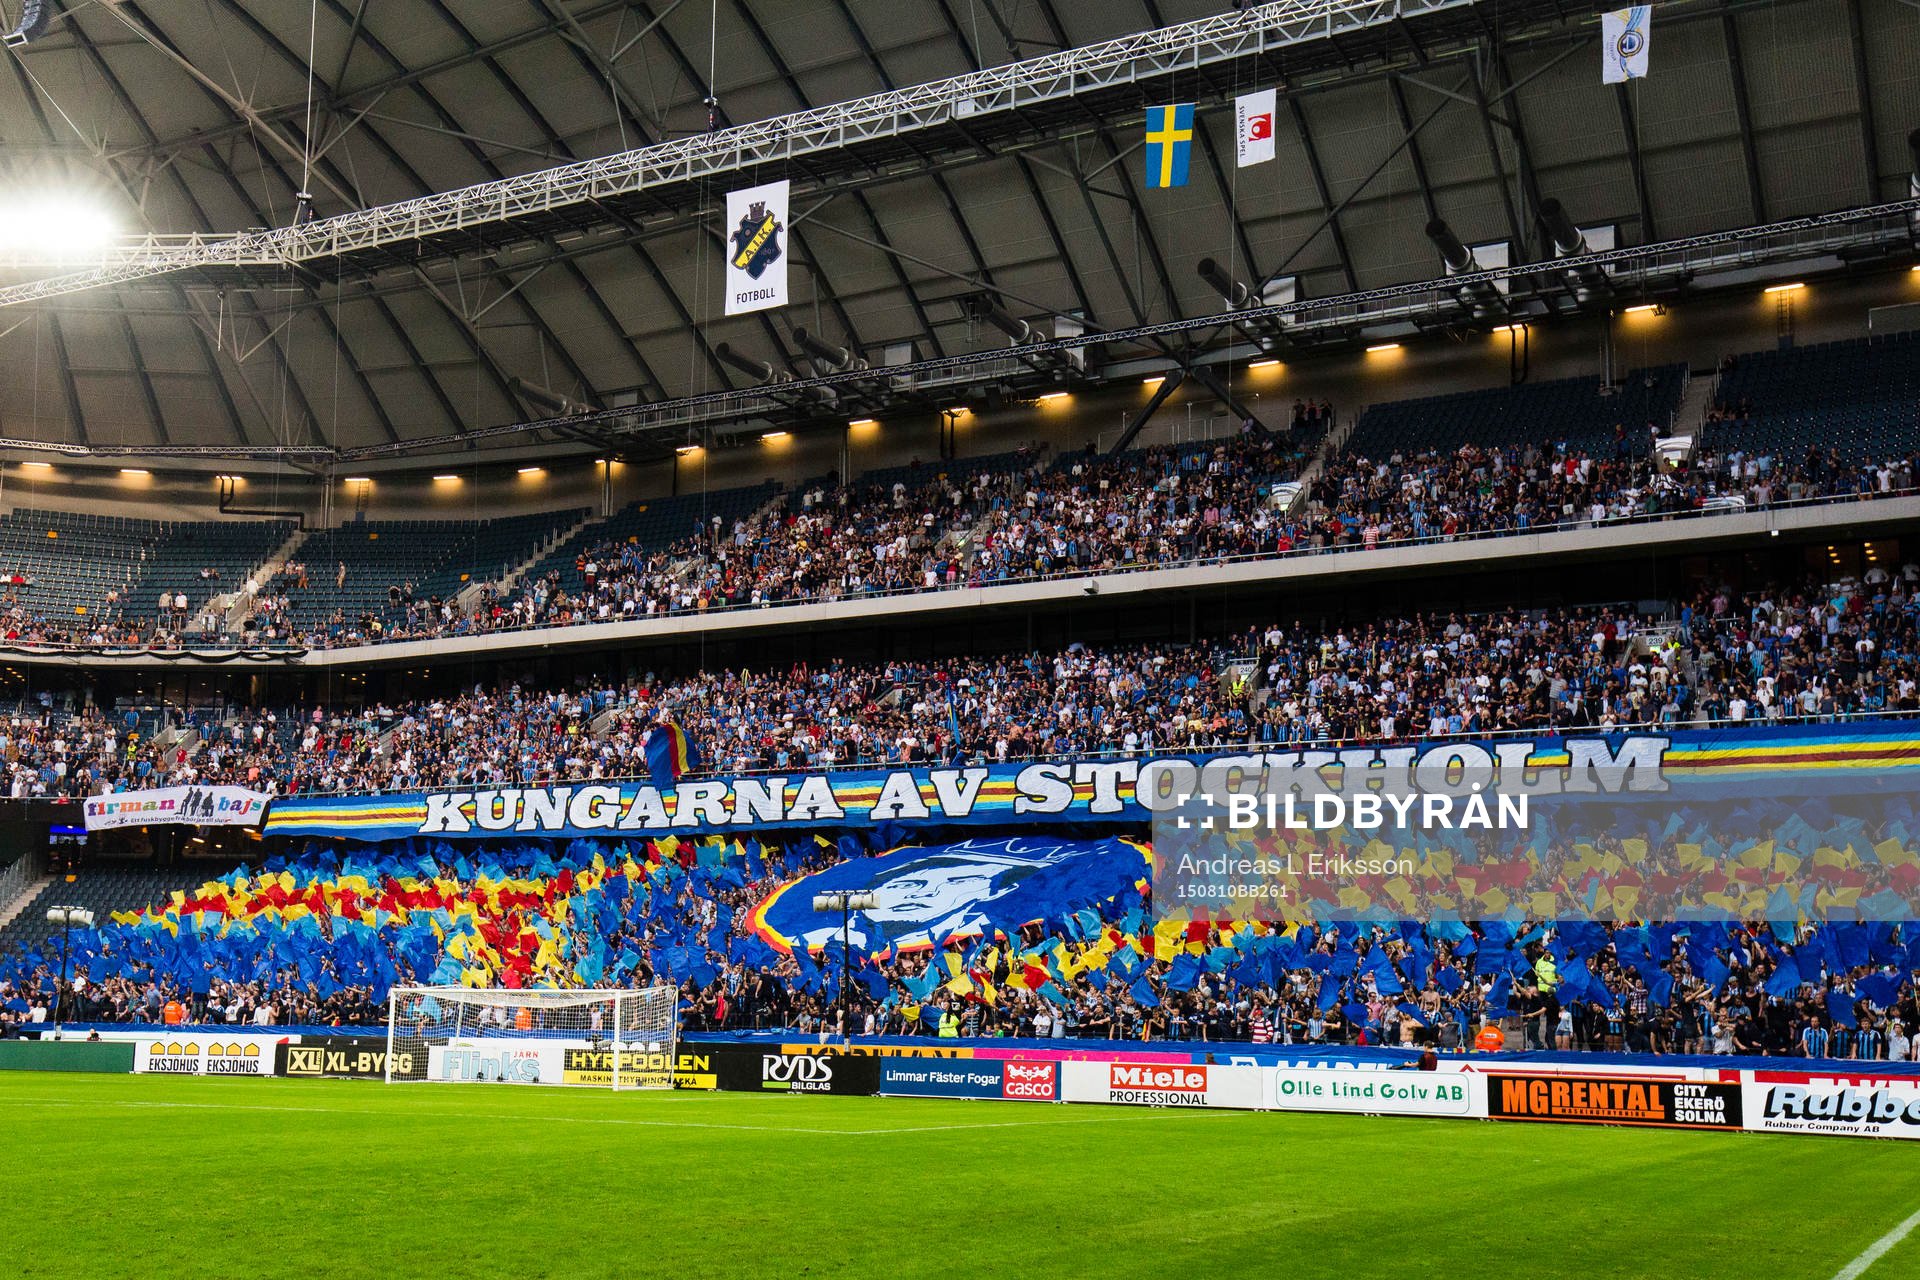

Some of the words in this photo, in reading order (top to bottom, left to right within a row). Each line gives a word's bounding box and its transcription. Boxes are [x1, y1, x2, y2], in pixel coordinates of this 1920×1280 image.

[1239, 140, 1247, 158] SPEL
[736, 287, 776, 304] FOTBOLL
[1648, 636, 1664, 645] 239
[418, 775, 847, 833] KUNGARNA
[869, 767, 989, 821] AV
[1014, 736, 1672, 816] STOCKHOLM
[217, 796, 263, 816] bajs
[149, 1055, 199, 1073] EKSJÖHUS
[207, 1056, 259, 1074] EKSJÖHUS
[289, 1050, 321, 1071] XL
[325, 1051, 413, 1074] XL-BYGG
[442, 1050, 540, 1081] Flinks
[571, 1052, 710, 1071] HYRPOOLEN
[762, 1054, 833, 1081] RYDS
[580, 1074, 664, 1084] MASKINTHYRNING
[791, 1081, 831, 1091] BILGLAS
[886, 1069, 928, 1083] Limmar
[929, 1071, 966, 1084] Fäster
[967, 1073, 1001, 1087] Fogar
[1111, 1065, 1206, 1090] Miele
[1005, 1082, 1053, 1097] casco
[1109, 1091, 1208, 1106] PROFESSIONAL
[1281, 1079, 1323, 1096] Olle
[1332, 1081, 1374, 1098] Lind
[1379, 1082, 1428, 1100] Golv
[1435, 1085, 1464, 1102] AB
[1673, 1084, 1708, 1097] CITY
[1674, 1096, 1725, 1111] EKERÖ
[1674, 1110, 1727, 1124] SOLNA
[1764, 1120, 1804, 1130] Rubber
[1807, 1122, 1860, 1133] Company
[1863, 1125, 1881, 1133] AB
